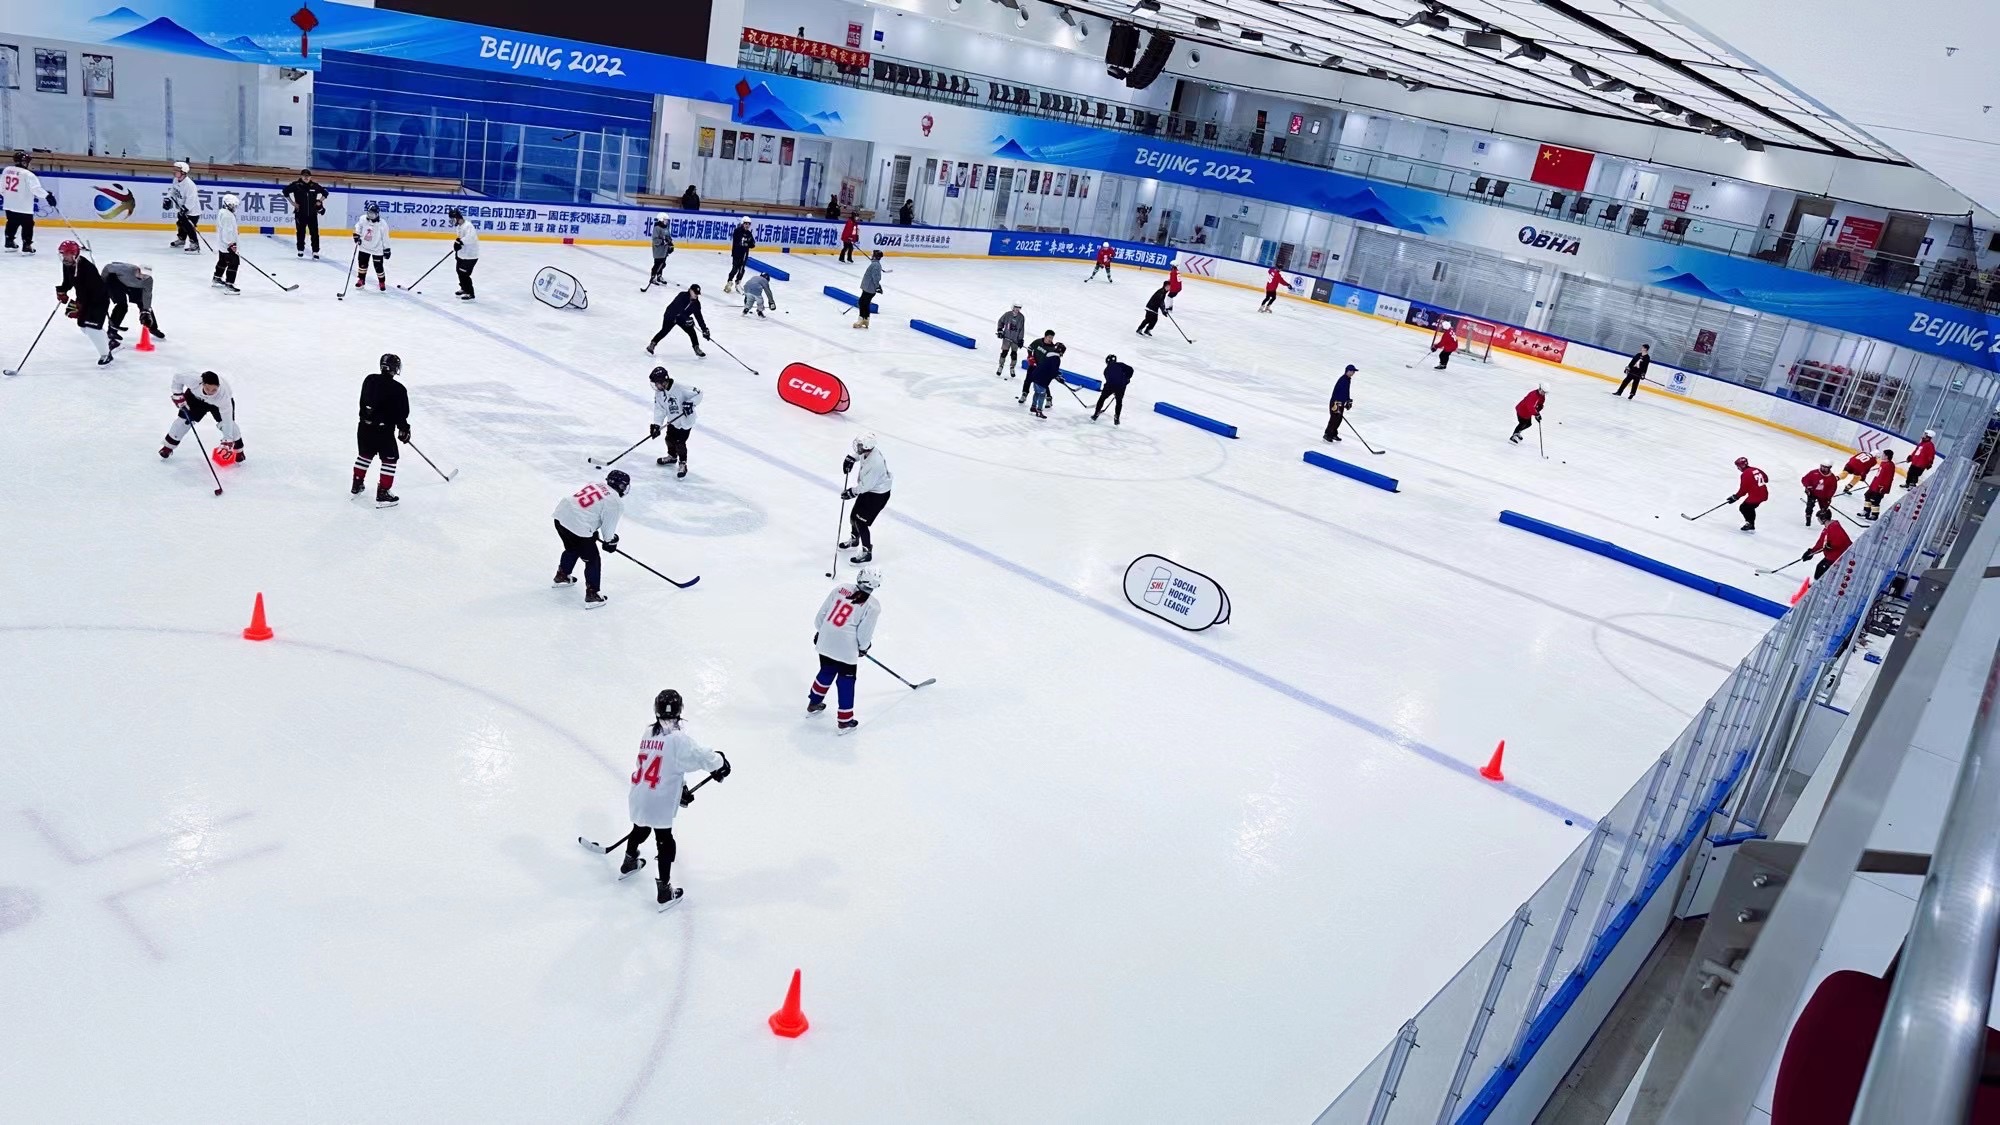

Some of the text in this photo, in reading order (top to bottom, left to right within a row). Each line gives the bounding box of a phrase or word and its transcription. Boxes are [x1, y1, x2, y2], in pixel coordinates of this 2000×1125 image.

[480, 36, 627, 77] BEIJING 2022
[1135, 148, 1255, 184] BEIJING 2022
[5, 176, 19, 192] 92
[241, 215, 272, 223] BUREAU
[421, 218, 580, 234] 2023京青少年冰球挑战赛
[1909, 312, 1988, 351] BEIJING
[788, 377, 831, 400] CCM
[573, 484, 603, 508] 55
[1150, 581, 1164, 590] SHL
[1172, 578, 1197, 595] SOCIAL
[1163, 598, 1190, 616] LEAGUE
[1168, 588, 1196, 606] HOCKEY
[827, 599, 853, 627] 18
[631, 754, 663, 788] 54
